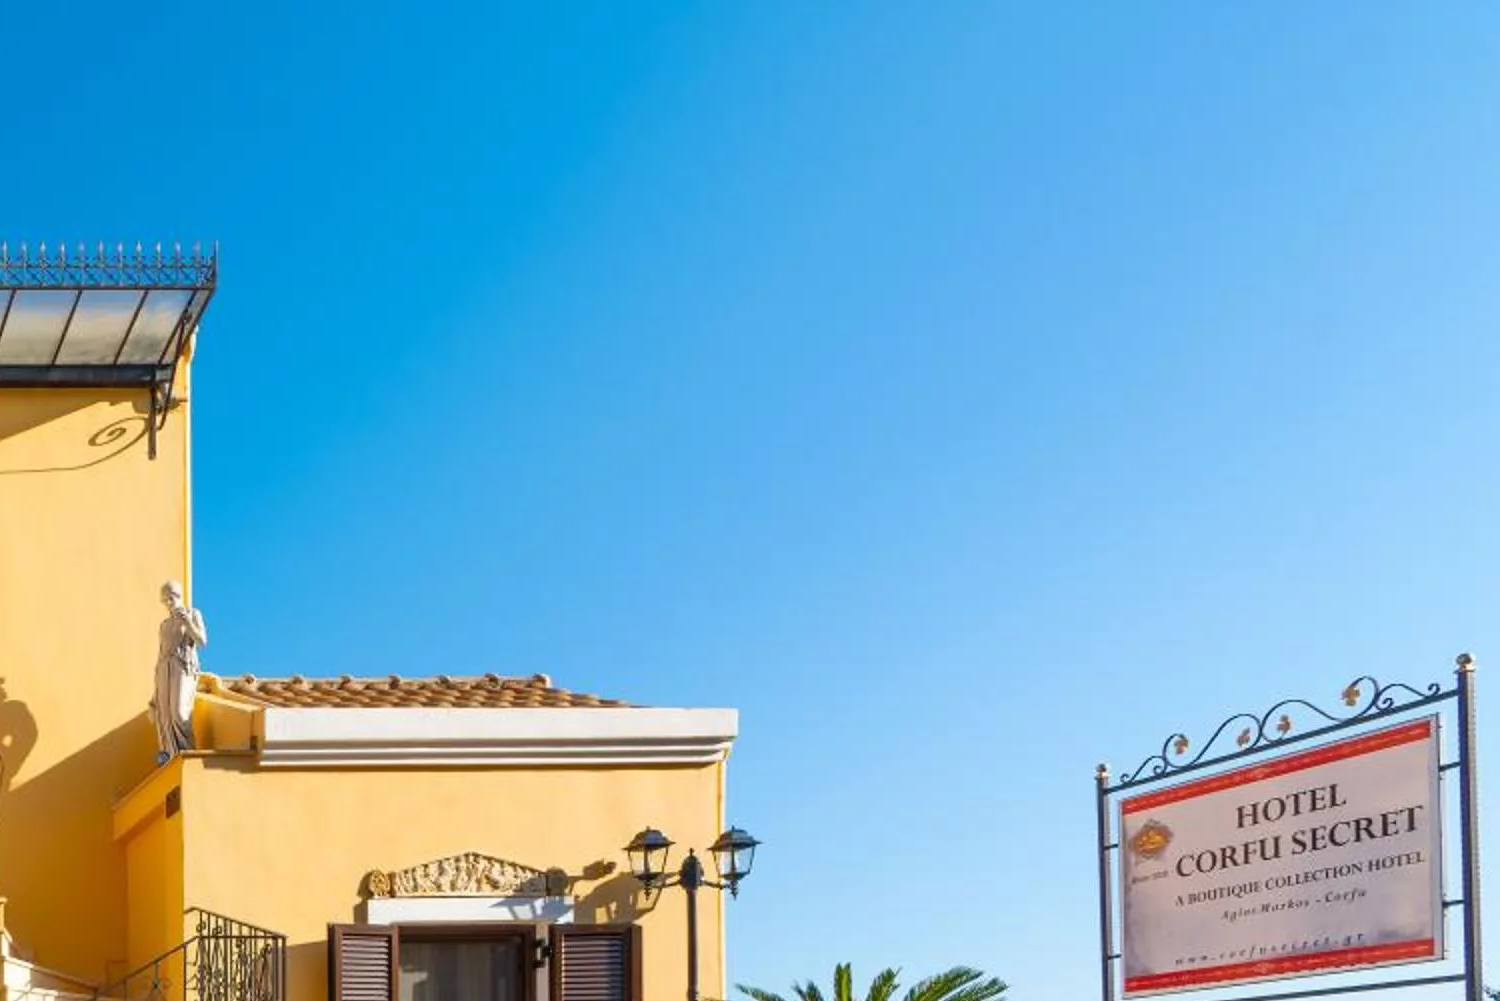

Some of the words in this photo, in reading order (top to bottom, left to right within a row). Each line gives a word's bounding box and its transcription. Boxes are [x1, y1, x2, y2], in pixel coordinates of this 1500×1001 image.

[1235, 783, 1347, 829] HOTEL
[1175, 836, 1281, 878] CORFU
[1291, 805, 1423, 857] SECRET
[1175, 895, 1185, 907] A
[1188, 878, 1263, 905] BOUTIQUE
[1265, 861, 1363, 892] COLLECTION
[1367, 851, 1425, 873] HOTEL
[1324, 887, 1367, 904] Corfu
